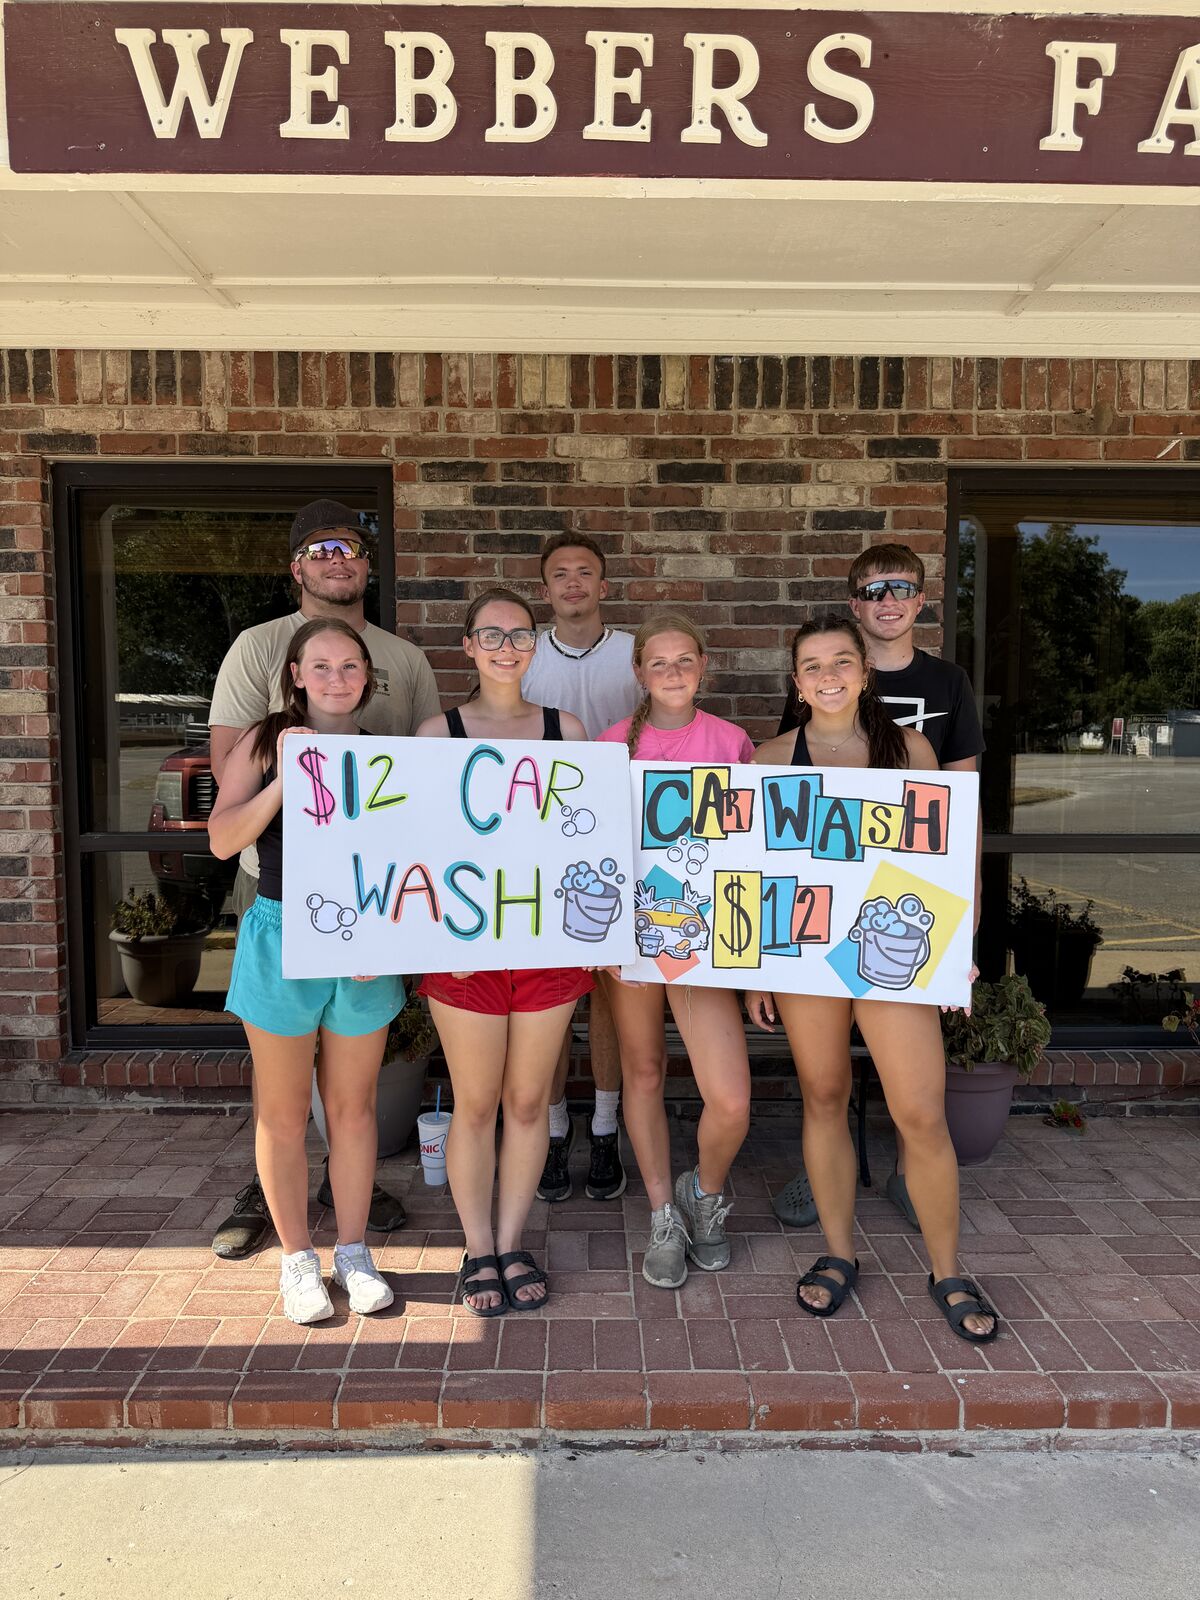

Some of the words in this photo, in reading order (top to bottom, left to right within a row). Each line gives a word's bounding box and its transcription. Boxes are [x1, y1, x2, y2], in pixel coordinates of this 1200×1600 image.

[115, 28, 874, 147] WEBBERS
[1039, 41, 1200, 155] FA
[297, 747, 408, 826] $12
[460, 744, 584, 835] CAR
[646, 772, 745, 842] CAR
[768, 779, 941, 859] WASH
[352, 852, 544, 941] WASH
[719, 874, 822, 957] $12
